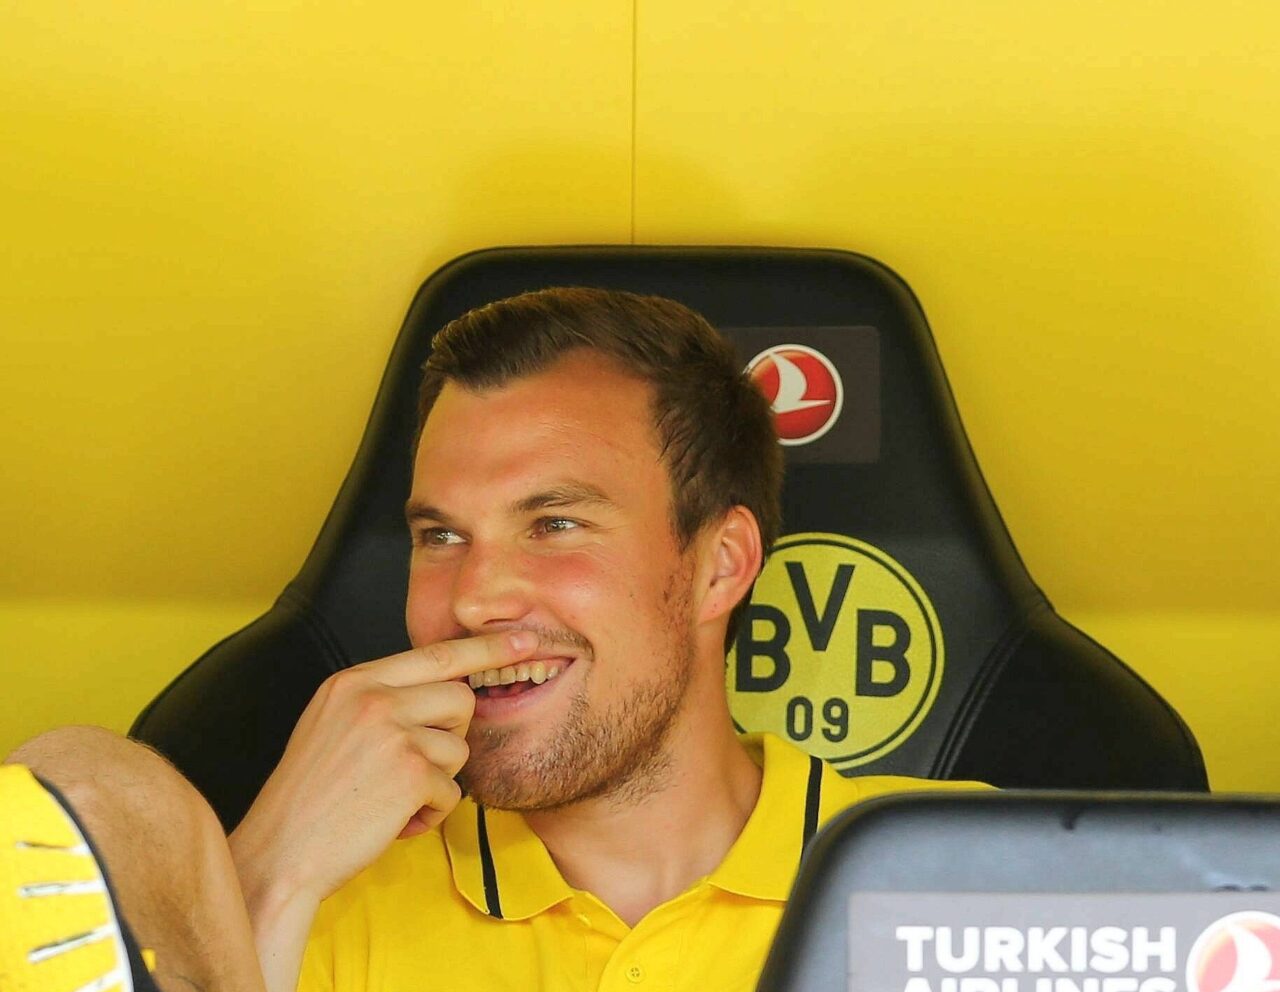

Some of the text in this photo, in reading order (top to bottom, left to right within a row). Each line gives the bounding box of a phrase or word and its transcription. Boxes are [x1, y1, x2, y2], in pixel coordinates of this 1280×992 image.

[735, 561, 912, 698] BVB
[786, 695, 850, 743] 09
[895, 925, 1177, 973] TURKISH
